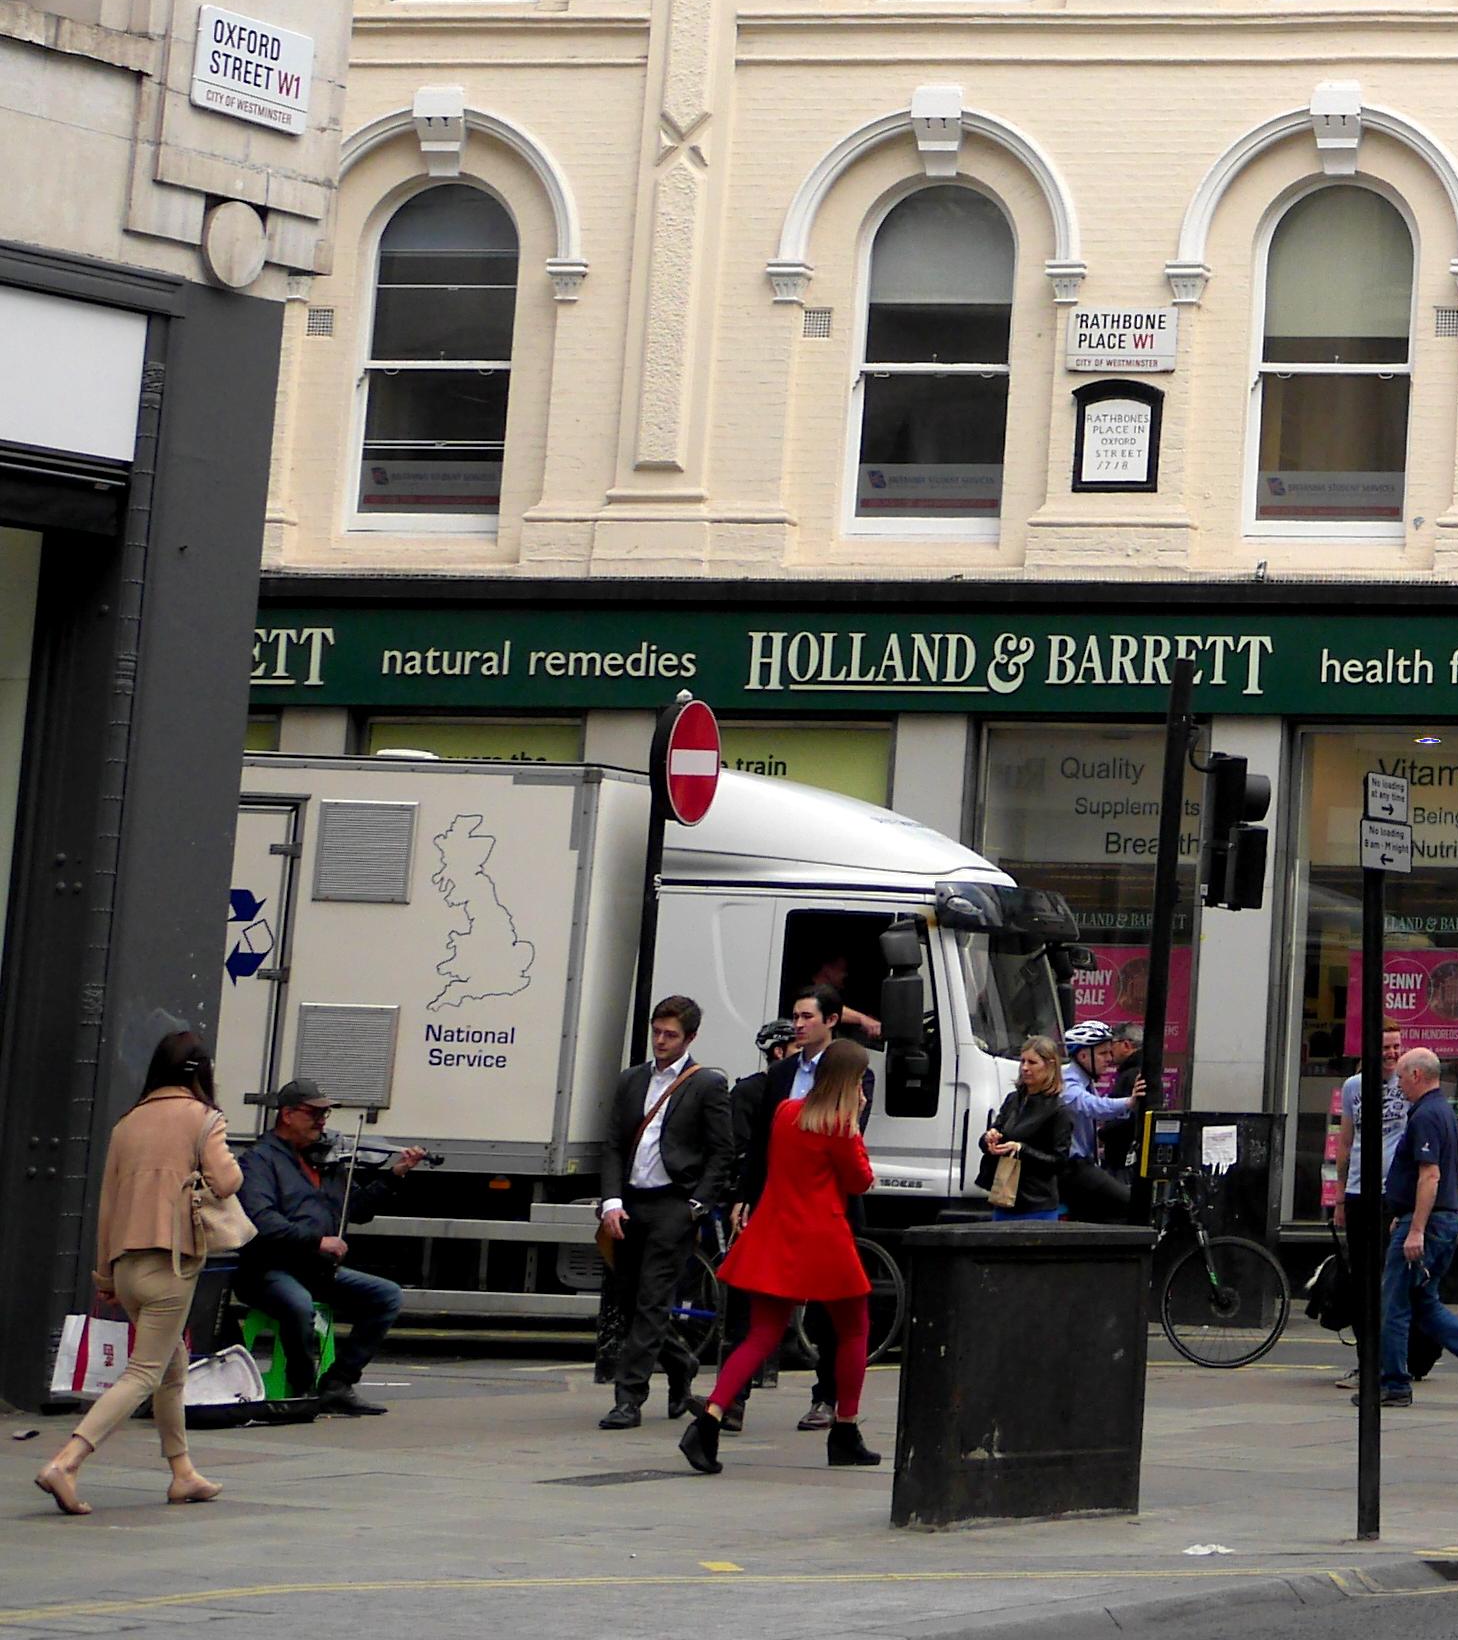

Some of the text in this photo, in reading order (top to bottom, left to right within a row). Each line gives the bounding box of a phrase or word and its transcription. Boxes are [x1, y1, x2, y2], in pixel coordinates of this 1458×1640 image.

[213, 19, 281, 61] OXFORD
[210, 50, 301, 99] STREET W1
[206, 89, 292, 125] CITY OF WESTMINSTER
[1079, 313, 1167, 329] RATHBONE
[1078, 333, 1154, 349] PLACE W1
[1075, 359, 1158, 368] CITY OF WESTMINSTER
[1086, 414, 1150, 423] RATHBONES
[1092, 425, 1145, 434] PLACE IN
[1101, 437, 1137, 446] OXFORD
[1095, 449, 1142, 458] STREET
[1096, 461, 1129, 470] 1718
[381, 640, 697, 678] natural remedies
[744, 630, 1274, 695] HOLLAND & BARRETT
[1320, 648, 1435, 685] health
[735, 754, 789, 777] train
[1060, 757, 1146, 785] Quality
[1074, 797, 1200, 819] Supplemts
[1425, 917, 1437, 932] &
[1075, 989, 1106, 1006] SALE
[1385, 993, 1416, 1009] SALE
[424, 1024, 516, 1045] National
[1422, 1029, 1458, 1040] HUNDREDS
[427, 1048, 508, 1069] Service
